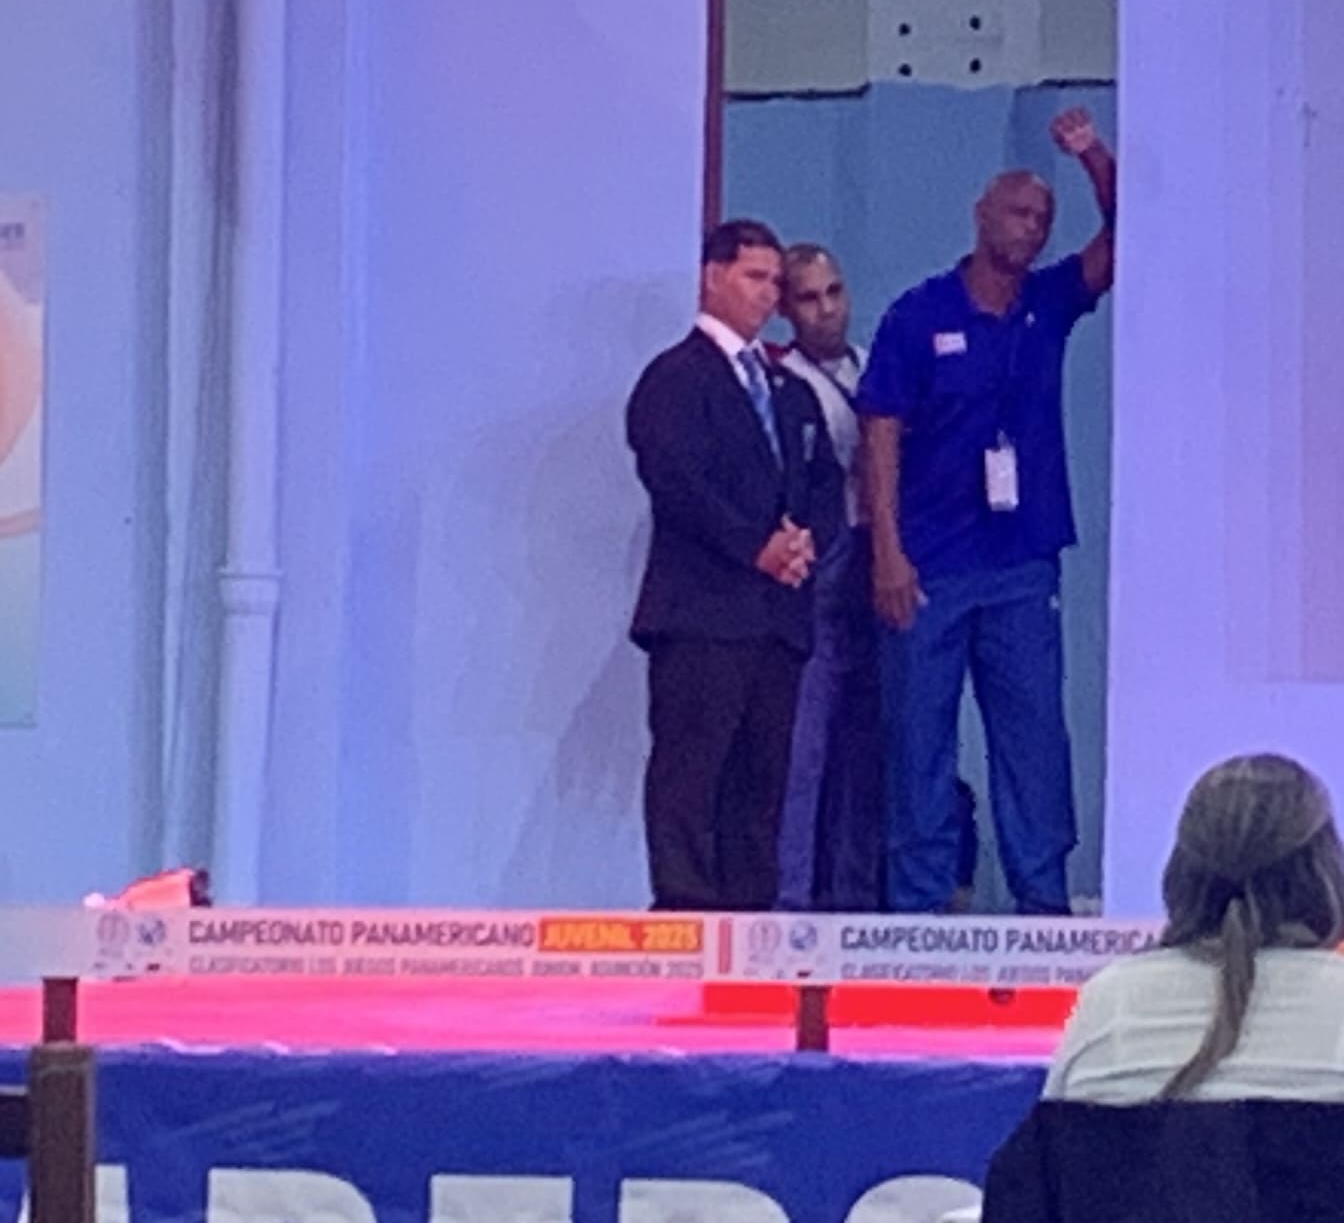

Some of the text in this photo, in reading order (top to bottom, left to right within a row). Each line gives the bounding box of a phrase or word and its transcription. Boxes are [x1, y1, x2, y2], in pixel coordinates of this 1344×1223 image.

[189, 920, 345, 946] CAMPEONATO
[351, 920, 535, 948] PANAMERICANO
[840, 925, 998, 953] CAMPEONATO
